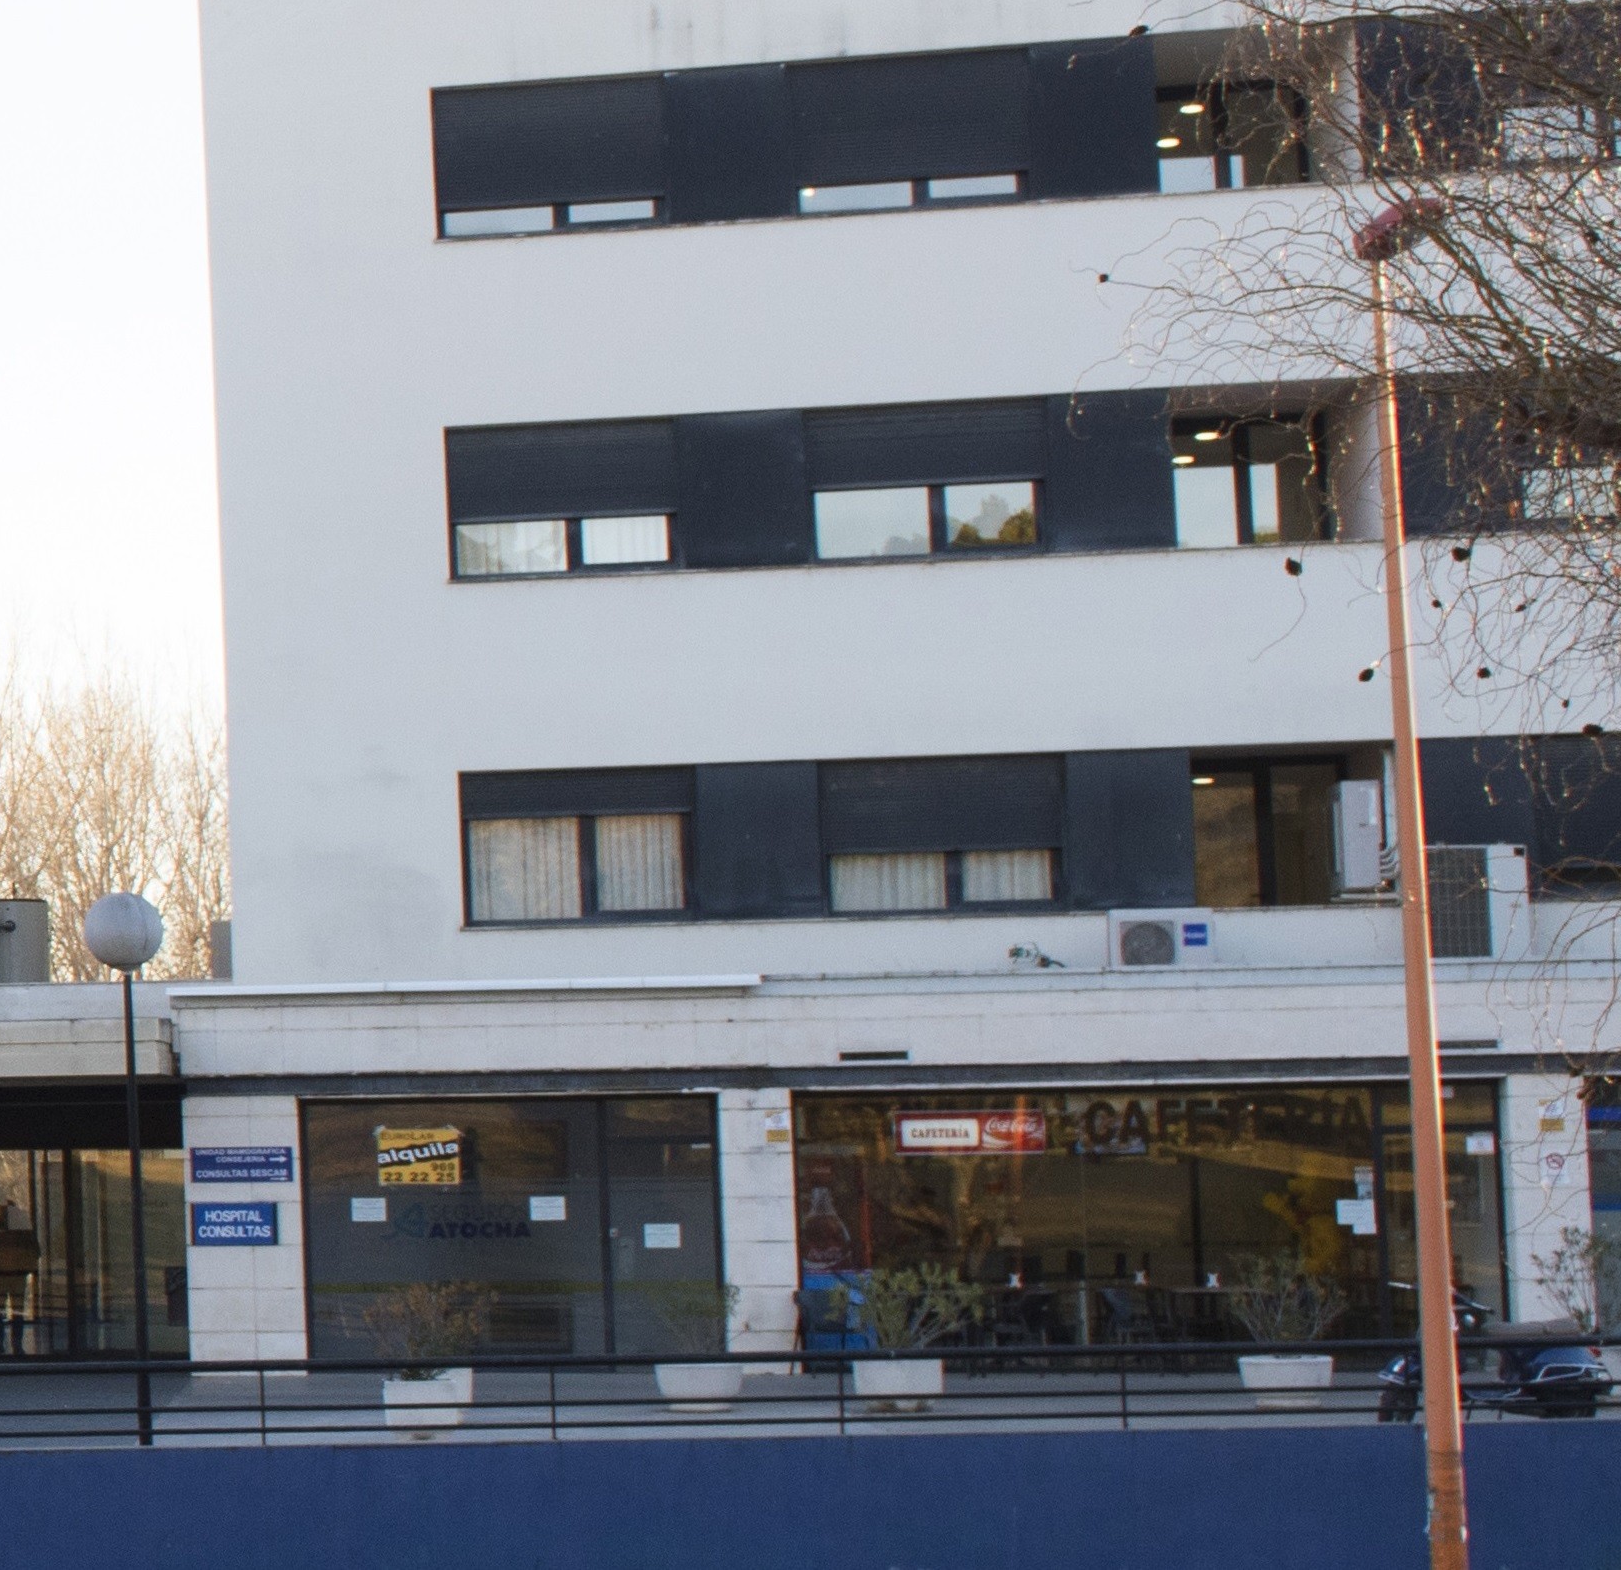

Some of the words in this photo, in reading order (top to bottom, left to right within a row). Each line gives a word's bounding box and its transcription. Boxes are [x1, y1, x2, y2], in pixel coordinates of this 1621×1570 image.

[377, 1142, 459, 1163] alquila
[195, 1169, 249, 1178] CONSULTAS
[250, 1168, 287, 1177] SESCAM
[383, 1171, 402, 1182] 22
[409, 1171, 429, 1182] 22
[436, 1171, 456, 1182] 25
[204, 1210, 263, 1222] HOSPITAL
[198, 1225, 271, 1238] CONSULTAS
[429, 1221, 531, 1239] ATOCHA
